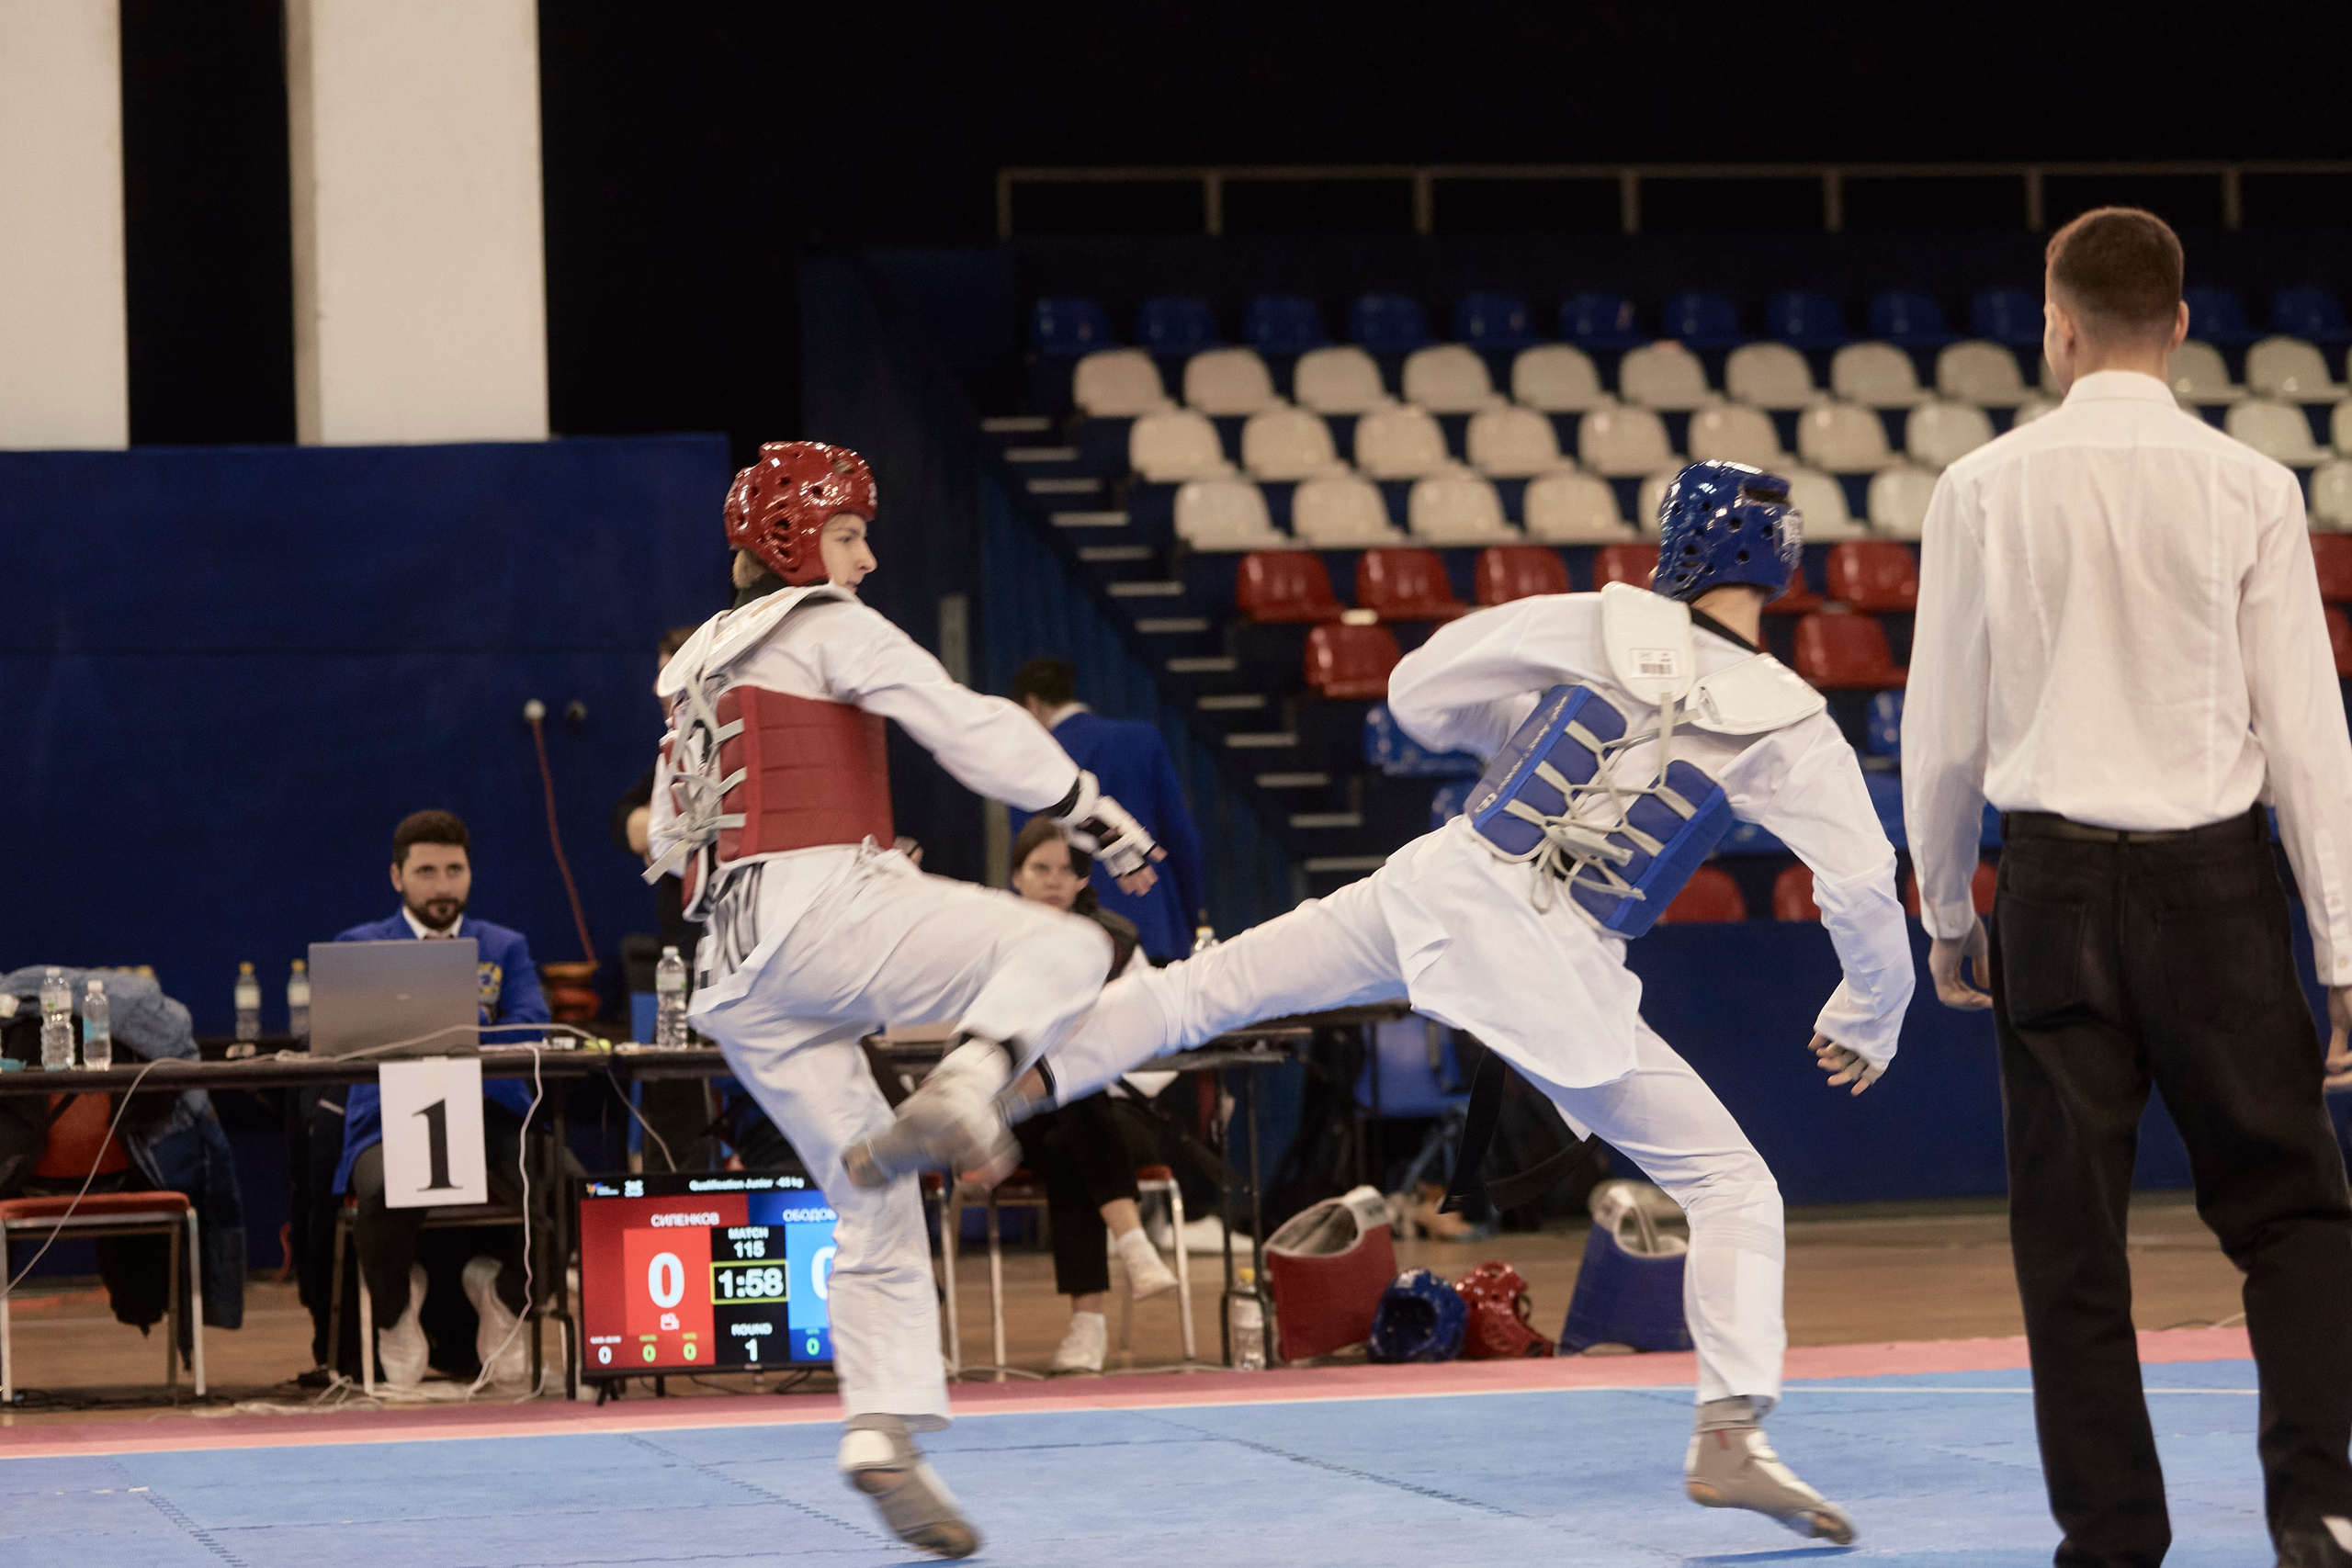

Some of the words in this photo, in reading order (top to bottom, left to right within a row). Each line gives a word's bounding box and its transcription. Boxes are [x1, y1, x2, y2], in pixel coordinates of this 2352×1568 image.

[412, 1097, 463, 1192] 1
[689, 1179, 745, 1191] Qualification
[744, 1178, 774, 1190] Junior
[650, 1212, 720, 1227] СИЛЕНКОВ
[728, 1226, 770, 1240] MATCH
[733, 1240, 766, 1258] 115
[648, 1252, 685, 1308] 0
[718, 1268, 785, 1298] 1:58
[731, 1323, 773, 1337] ROUND
[598, 1346, 612, 1364] 0
[643, 1344, 656, 1362] 0
[683, 1342, 696, 1361] 0
[745, 1338, 758, 1361] 1
[806, 1337, 820, 1356] 0
